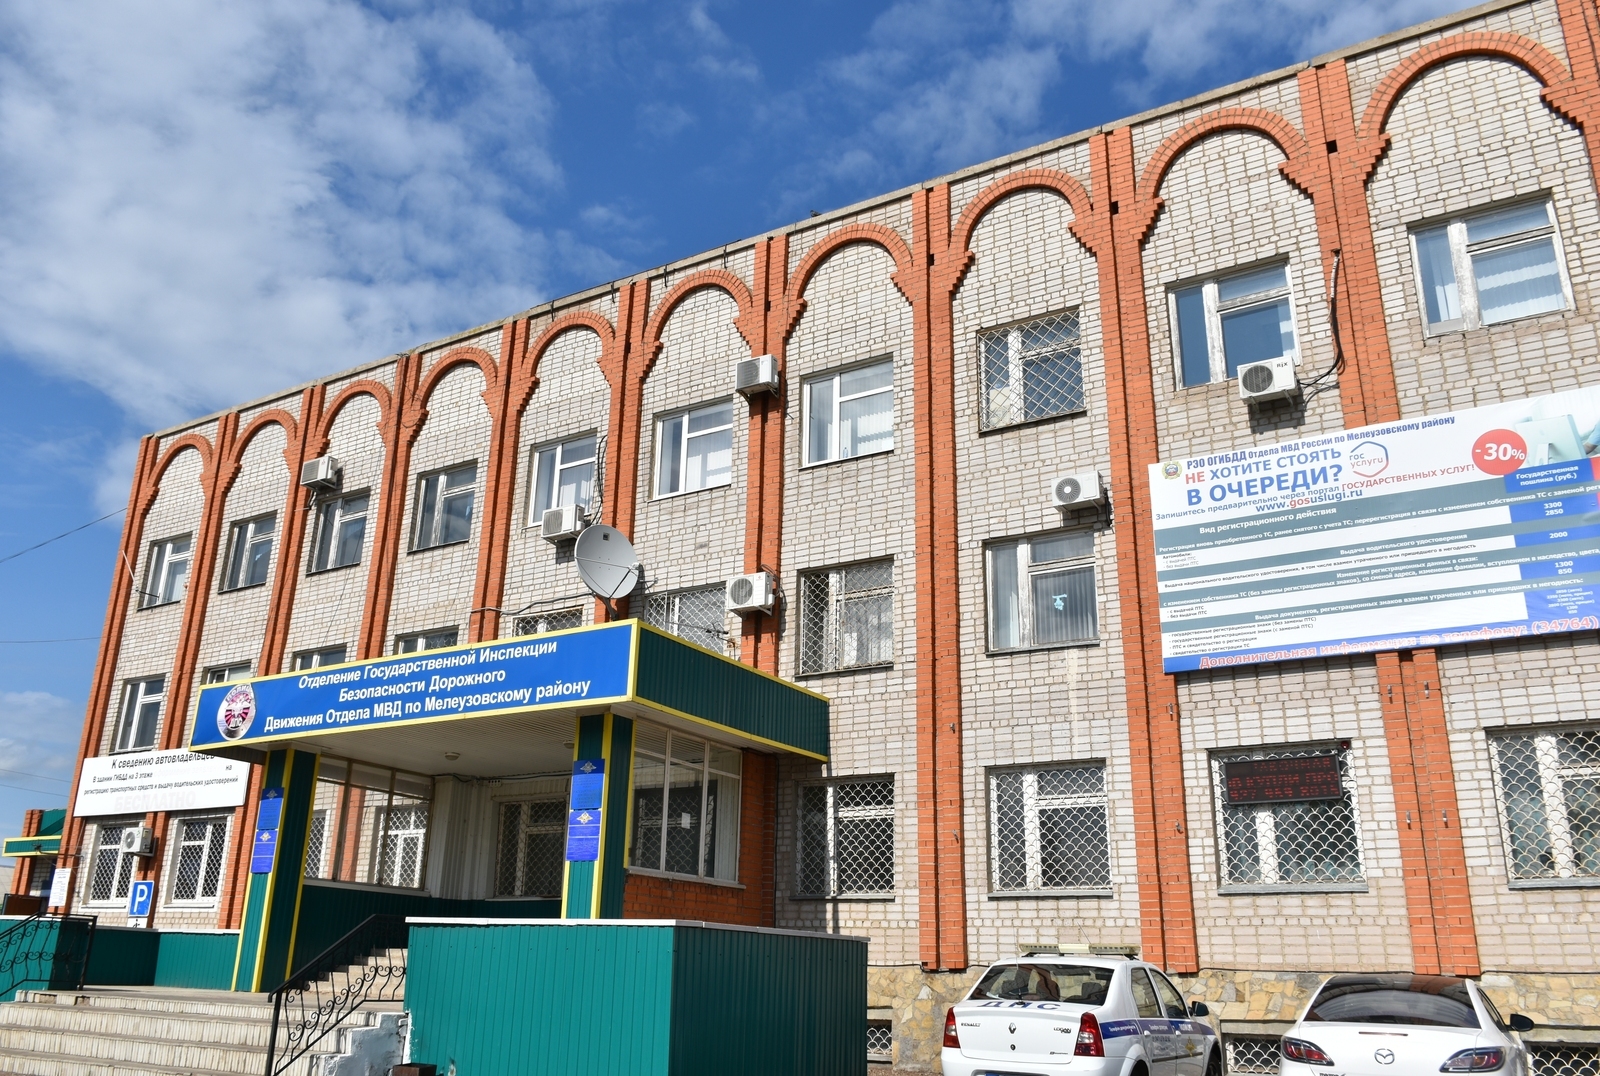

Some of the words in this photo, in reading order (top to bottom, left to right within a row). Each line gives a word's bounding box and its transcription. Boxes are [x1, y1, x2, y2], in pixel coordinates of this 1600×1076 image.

[1187, 458, 1204, 469] РЭО
[1207, 450, 1246, 465] ОГИБДД
[1248, 446, 1278, 458] Отдела
[1280, 442, 1299, 452] МВД
[1301, 438, 1332, 448] России
[1346, 422, 1419, 440] Мелеузовскому
[1421, 416, 1454, 428] району
[1349, 452, 1364, 461] гос
[1185, 471, 1204, 484] НЕ
[1210, 459, 1271, 480] ХОТИТЕ
[1276, 448, 1340, 467] СТОЯТЬ
[1516, 466, 1578, 478] Государственная
[1520, 477, 1553, 485] пошлина
[1554, 472, 1576, 481] (руб.)
[1156, 508, 1205, 520] Запишитесь
[1207, 496, 1277, 511] предварительно
[1280, 491, 1304, 499] через
[1306, 486, 1339, 495] портал
[1342, 470, 1436, 491] ГОСУДАРСТВЕННЫХ
[1440, 463, 1476, 475] УСЛУГ!
[1187, 488, 1201, 505] В
[1209, 464, 1342, 501] ОЧЕРЕДИ?
[1254, 489, 1362, 511] www.gosuslugi.ru
[1158, 542, 1195, 553] Регистрация
[1214, 533, 1262, 545] приобретенного
[1354, 511, 1411, 524] перерегистрация
[1443, 501, 1486, 511] изменением
[1486, 494, 1536, 505] собственника
[1553, 486, 1584, 496] заменой
[1216, 514, 1294, 532] регистрационного
[1295, 507, 1336, 520] действия
[1162, 551, 1192, 560] Автомобили:
[1365, 540, 1415, 551] водительского
[1415, 534, 1467, 545] удостоверения
[1167, 598, 1201, 607] изменением
[1200, 593, 1238, 603] собственника
[1260, 588, 1283, 596] замены
[1283, 581, 1336, 593] регистрационных
[1336, 576, 1362, 587] знаков),
[1370, 572, 1394, 582] сменой
[1393, 570, 1418, 580] адреса,
[1418, 566, 1454, 576] изменение
[1453, 562, 1486, 572] фамилии,
[1486, 557, 1530, 568] вступлением
[1536, 551, 1578, 560] наследство,
[1183, 577, 1221, 585] национального
[1222, 572, 1259, 580] водительского
[1259, 567, 1300, 576] удостоверения,
[1353, 555, 1388, 564] утраченного
[1400, 548, 1437, 557] пришедшего
[1336, 569, 1370, 578] Изменение
[1370, 562, 1425, 574] регистрационных
[1279, 608, 1318, 617] документов,
[1320, 601, 1377, 612] регистрационных
[1429, 590, 1471, 600] утраченных
[1487, 583, 1531, 593] пришедших
[1538, 576, 1583, 587] негодность:
[1199, 648, 1316, 668] Дополнительная
[1321, 638, 1416, 655] информация
[1419, 632, 1440, 644] по
[1444, 626, 1528, 642] телефону:
[1532, 616, 1598, 634] (34764)
[299, 670, 360, 688] Отделение
[364, 650, 476, 681] Государственной
[480, 642, 557, 662] Инспекции
[339, 680, 425, 702] Безопасности
[428, 670, 506, 692] Дорожного
[264, 713, 323, 732] Движения
[326, 708, 370, 724] Отдела
[374, 701, 401, 718] МВД
[405, 701, 421, 714] по
[424, 688, 532, 712] Мелеузовскому
[536, 679, 591, 702] району
[97, 775, 113, 783] здании
[113, 773, 128, 782] ГИБДД
[111, 760, 117, 769] К
[118, 757, 153, 769] сведению
[84, 788, 109, 796] регистрацию
[110, 785, 136, 794] транспортных
[138, 784, 154, 792] средств
[158, 782, 173, 790] выдачу
[174, 780, 203, 789] водительских
[204, 776, 238, 787] удостоверений
